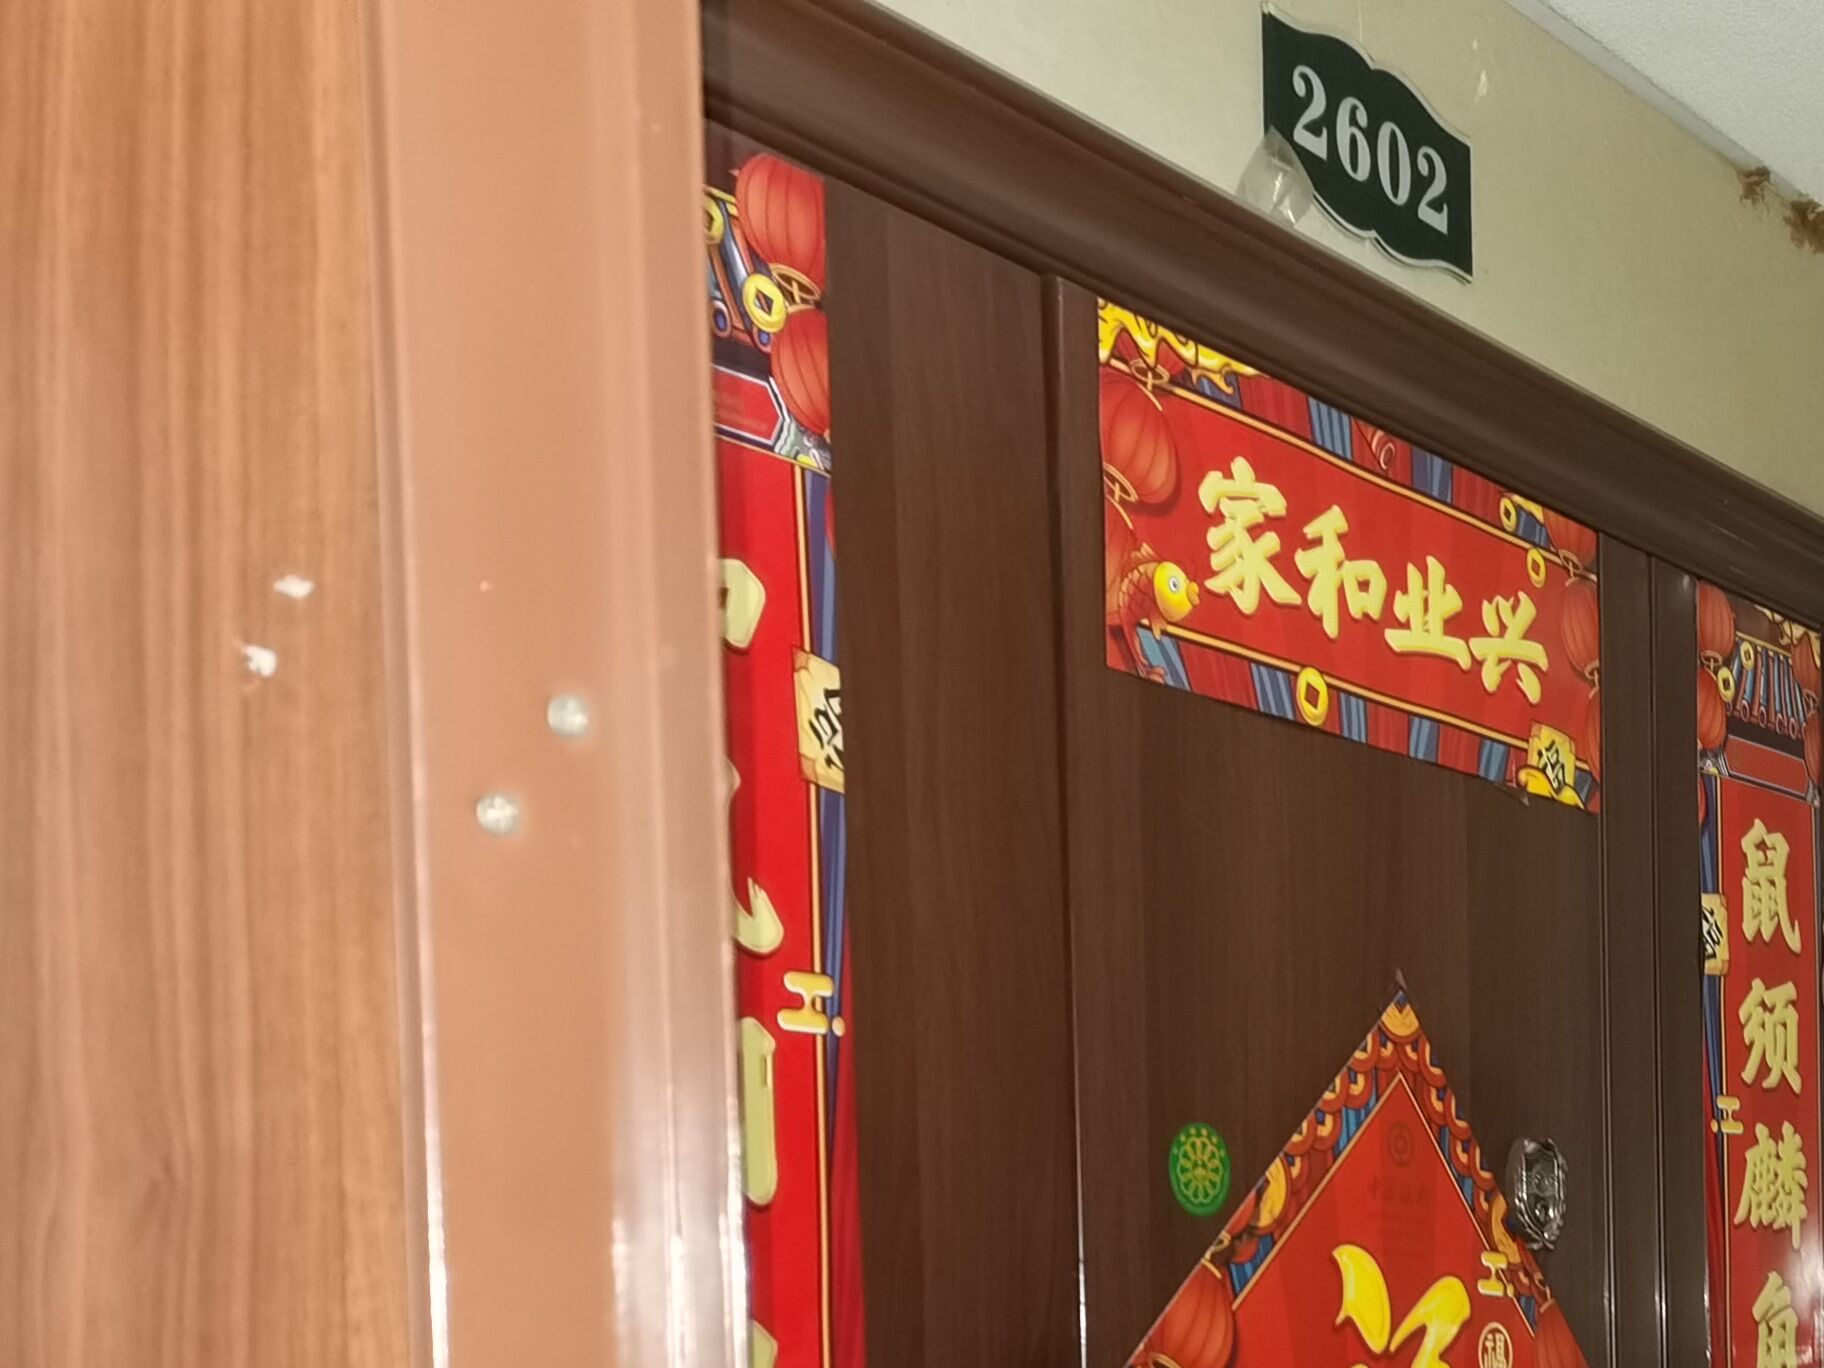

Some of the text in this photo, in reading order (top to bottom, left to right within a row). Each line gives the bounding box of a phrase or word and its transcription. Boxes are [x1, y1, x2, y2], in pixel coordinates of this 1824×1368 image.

[1291, 63, 1450, 236] 2602
[1196, 455, 1550, 706] 家和业兴
